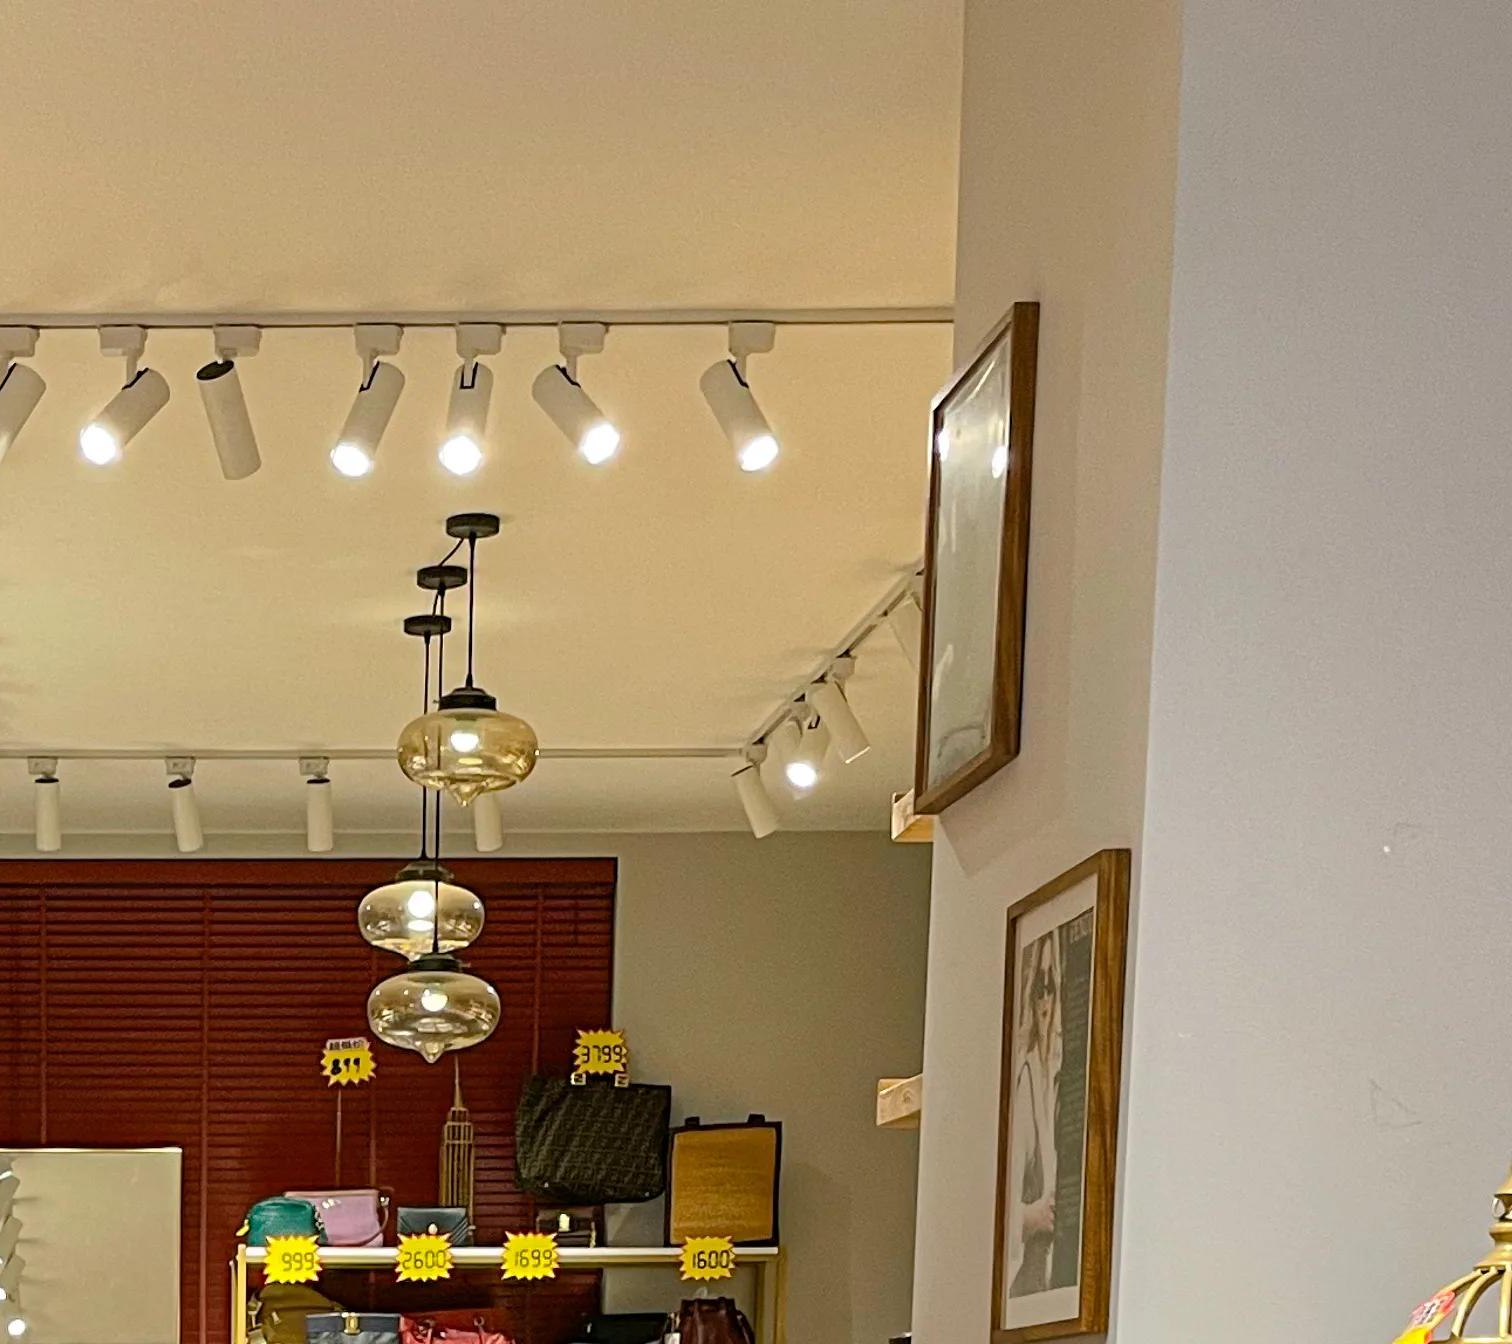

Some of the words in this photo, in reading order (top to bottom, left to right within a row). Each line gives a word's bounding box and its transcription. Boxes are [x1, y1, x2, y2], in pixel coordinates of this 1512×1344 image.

[581, 1044, 623, 1064] 3799
[282, 1252, 315, 1272] 999
[402, 1249, 446, 1271] 2600
[514, 1249, 553, 1269] 1699
[692, 1249, 731, 1270] 1600
